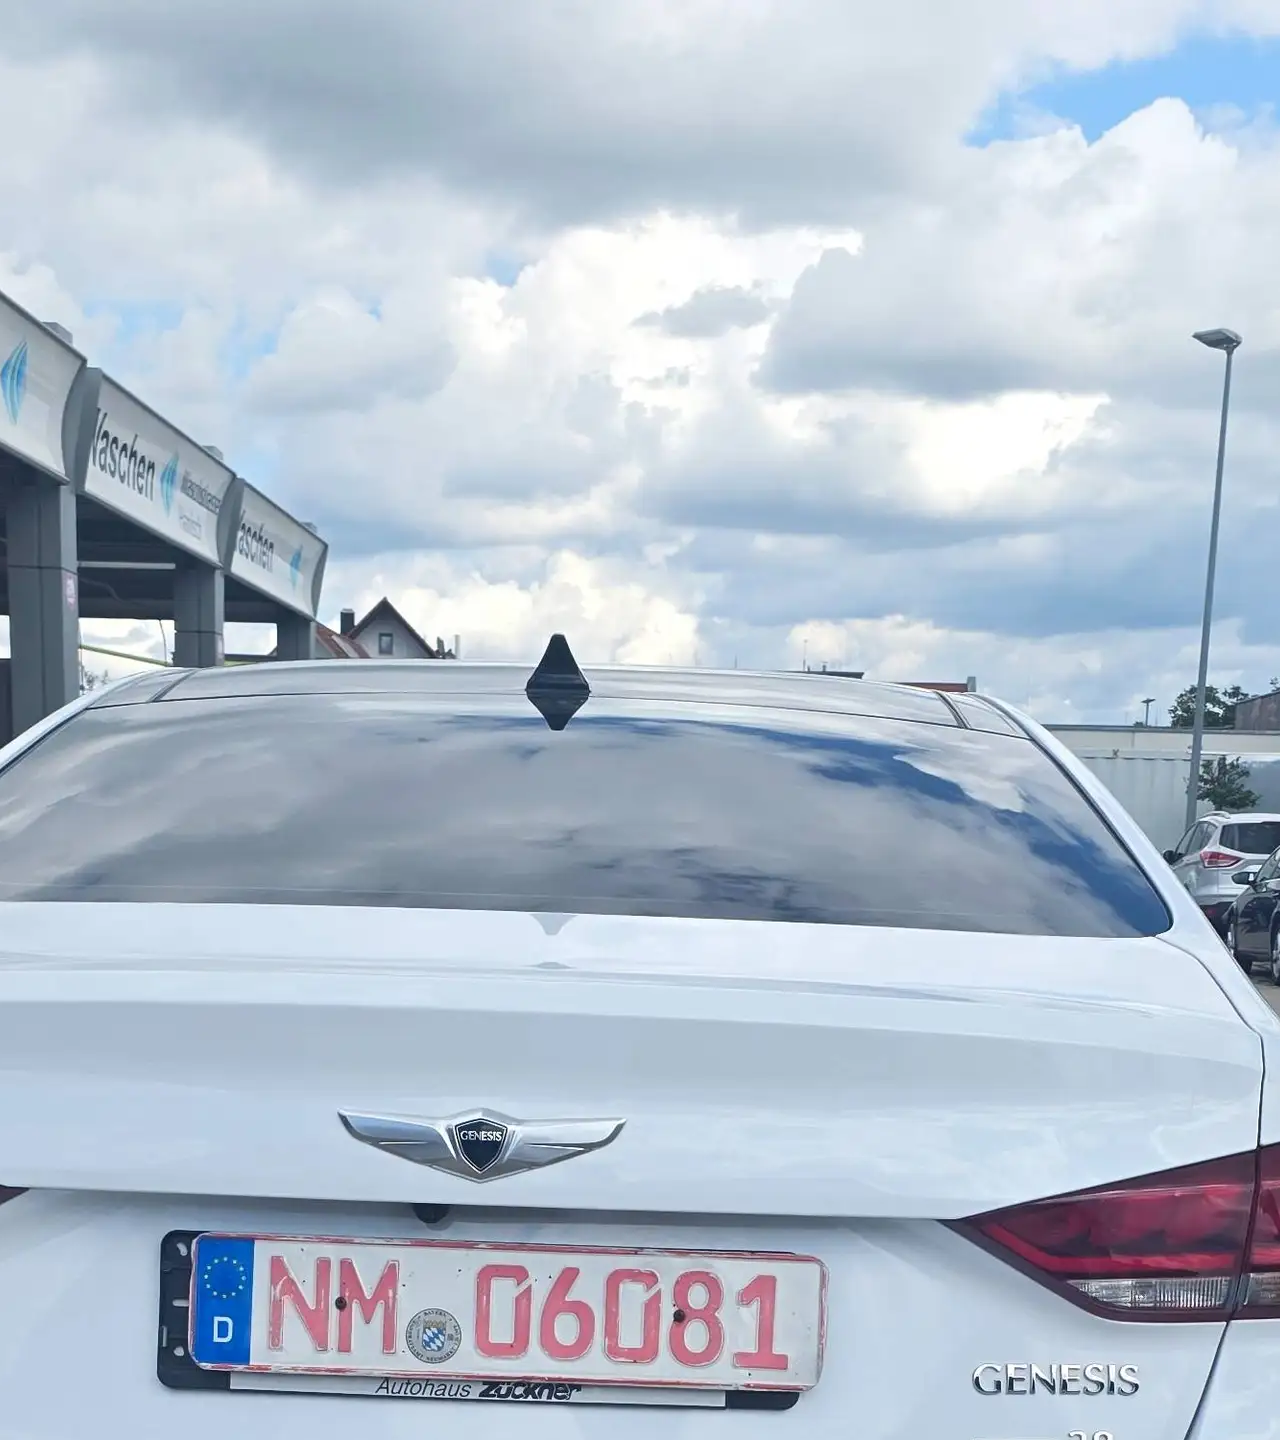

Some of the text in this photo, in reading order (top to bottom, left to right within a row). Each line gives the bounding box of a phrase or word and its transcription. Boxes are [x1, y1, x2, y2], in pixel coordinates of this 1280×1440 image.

[460, 1130, 502, 1142] GENESIS
[269, 1255, 400, 1354] NM
[474, 1263, 790, 1371] 06081
[212, 1316, 234, 1343] D
[375, 1377, 472, 1397] Autohaus
[972, 1363, 1140, 1396] GENESIS
